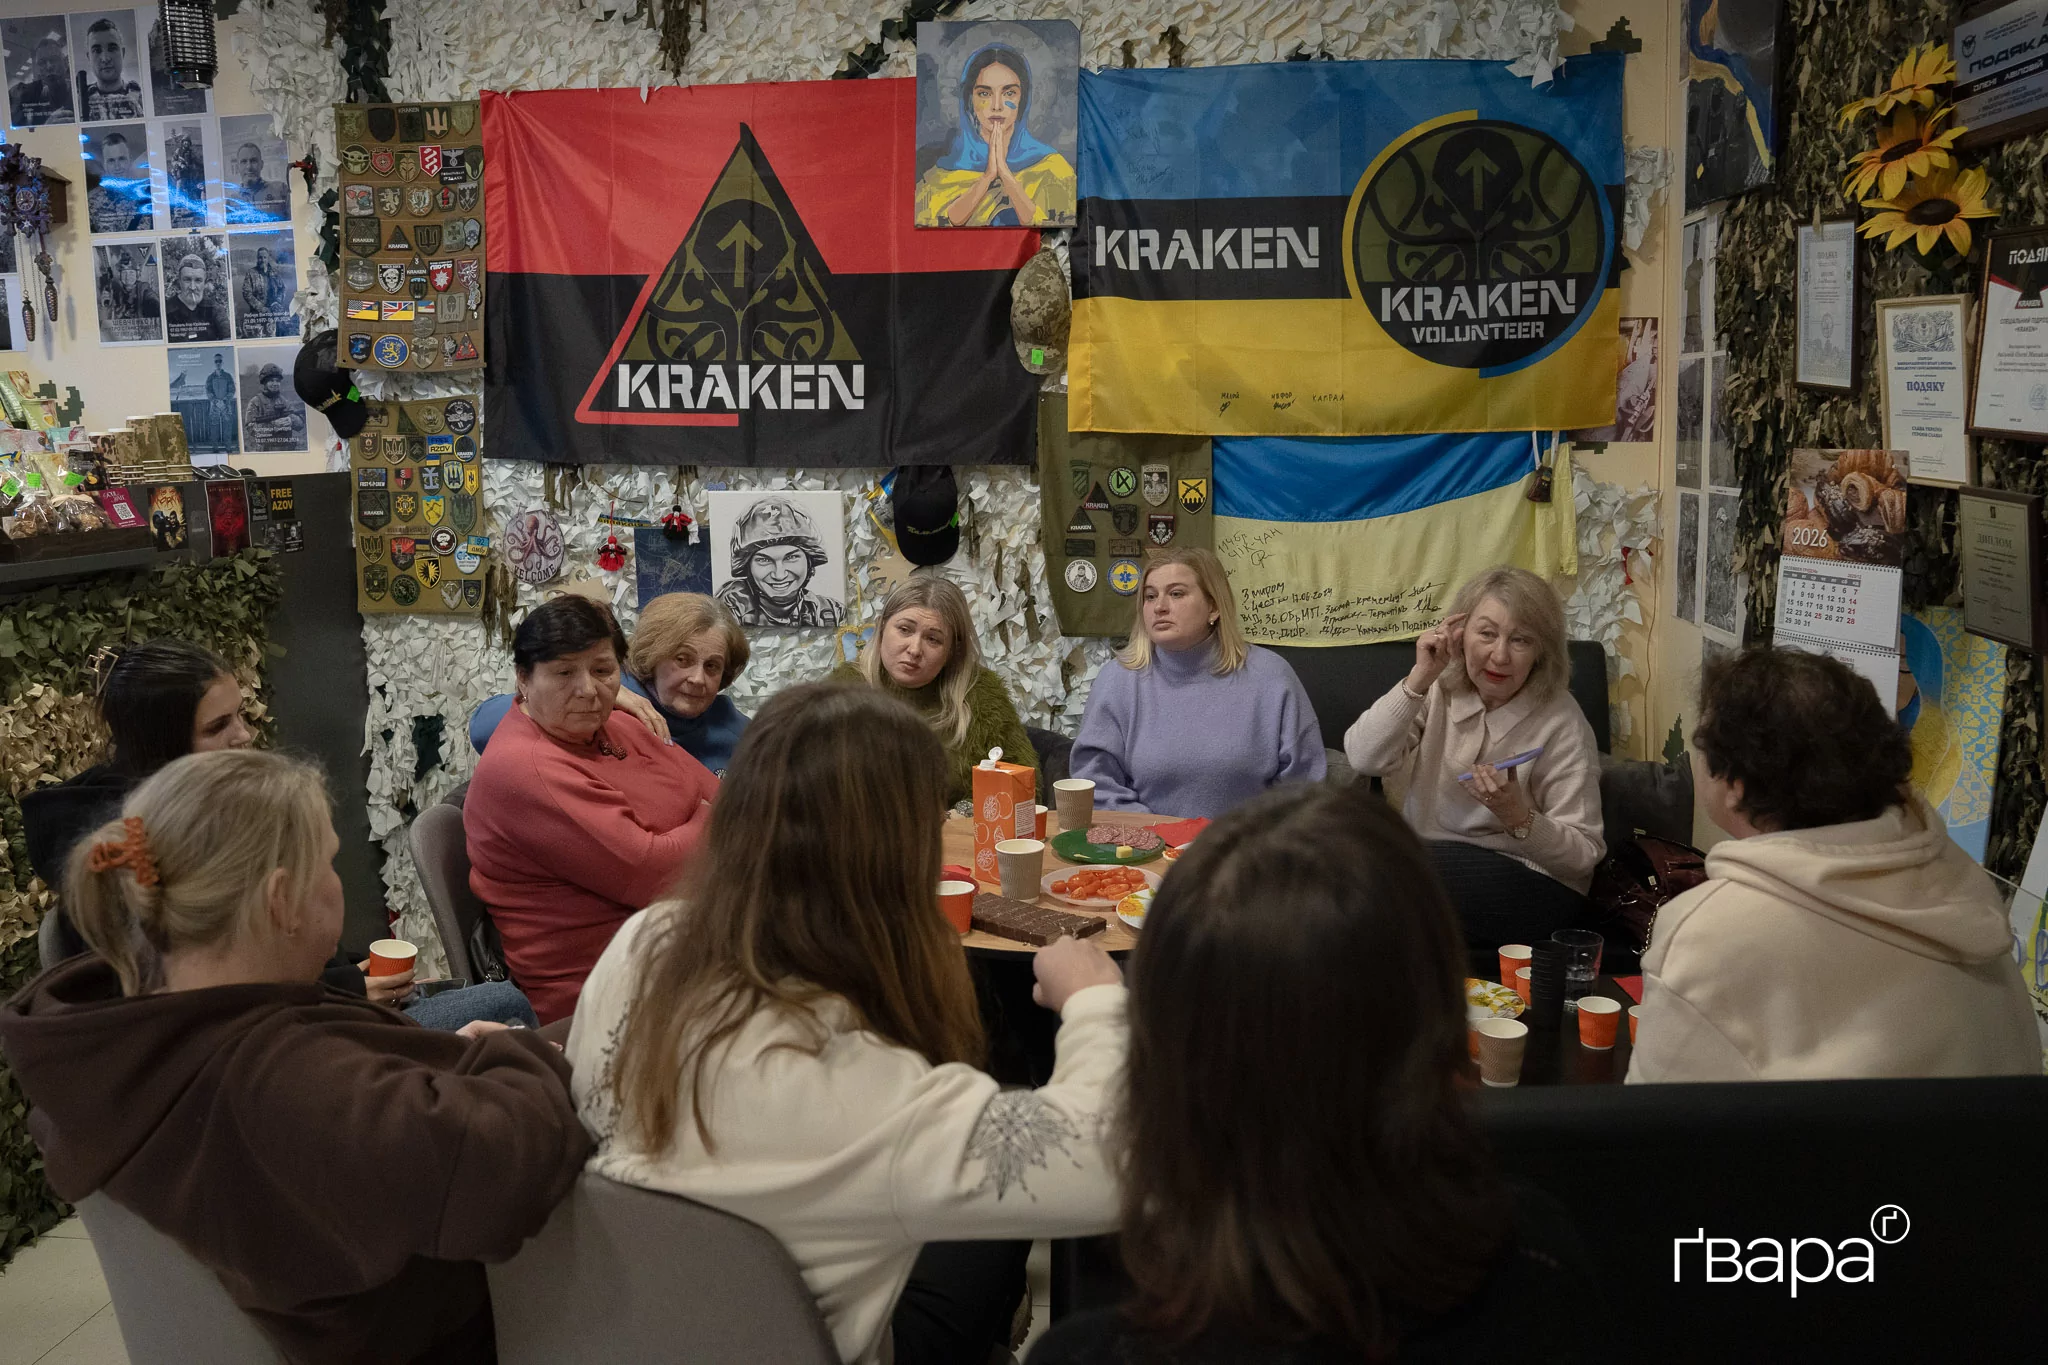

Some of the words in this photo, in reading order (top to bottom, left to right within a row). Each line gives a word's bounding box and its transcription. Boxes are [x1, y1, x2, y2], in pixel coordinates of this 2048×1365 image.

[1095, 225, 1319, 271] KRAKEN
[1381, 278, 1576, 322] KRAKEN
[1411, 321, 1545, 344] VOLUNTEER
[618, 362, 865, 410] KRAKEN
[1906, 381, 1945, 393] ПОДЯКУ
[270, 488, 292, 499] FREE
[272, 500, 293, 511] AZOV
[1792, 527, 1828, 548] 2026
[514, 563, 557, 581] WELCOME
